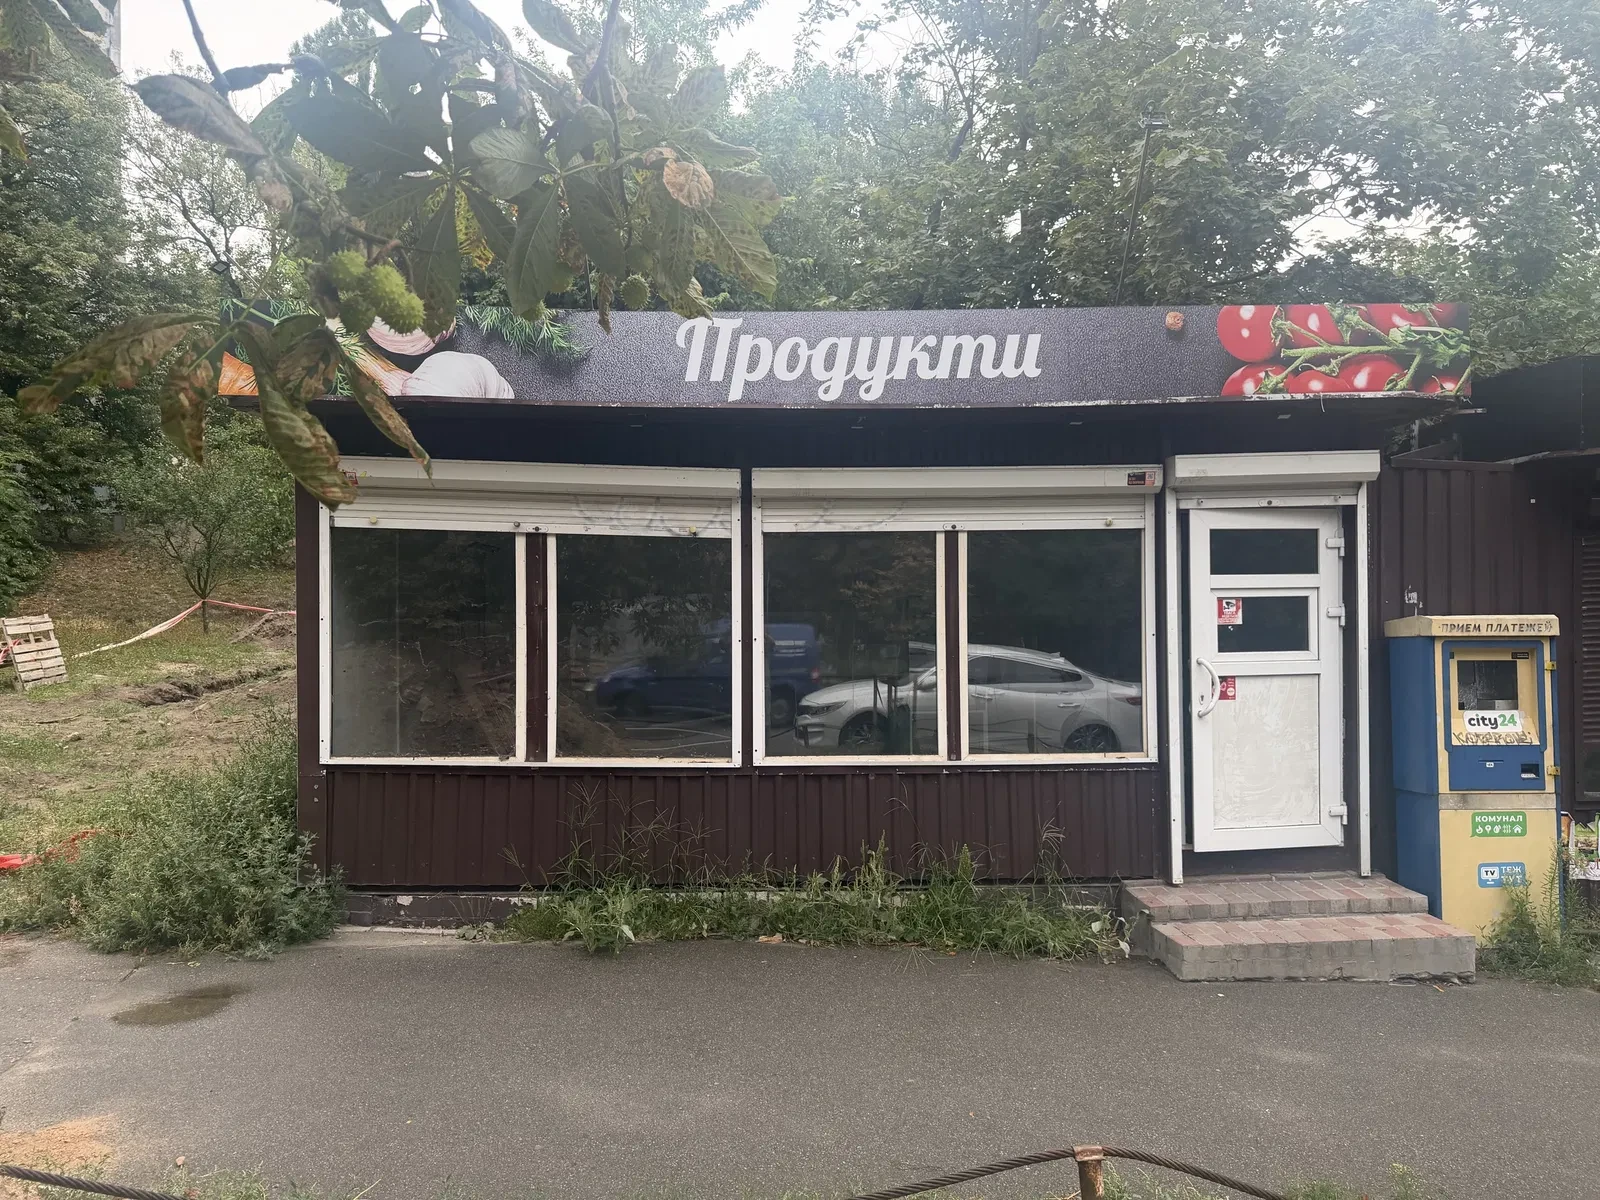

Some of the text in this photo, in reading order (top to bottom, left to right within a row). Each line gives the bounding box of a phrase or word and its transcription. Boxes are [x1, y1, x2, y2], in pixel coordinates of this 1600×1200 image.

[675, 317, 1042, 402] Продукти
[1441, 620, 1553, 633] ПРИЕМ ПЛАТЕЖЕЙ
[1467, 713, 1518, 730] city24
[1475, 815, 1523, 823] КОМУНАЛ
